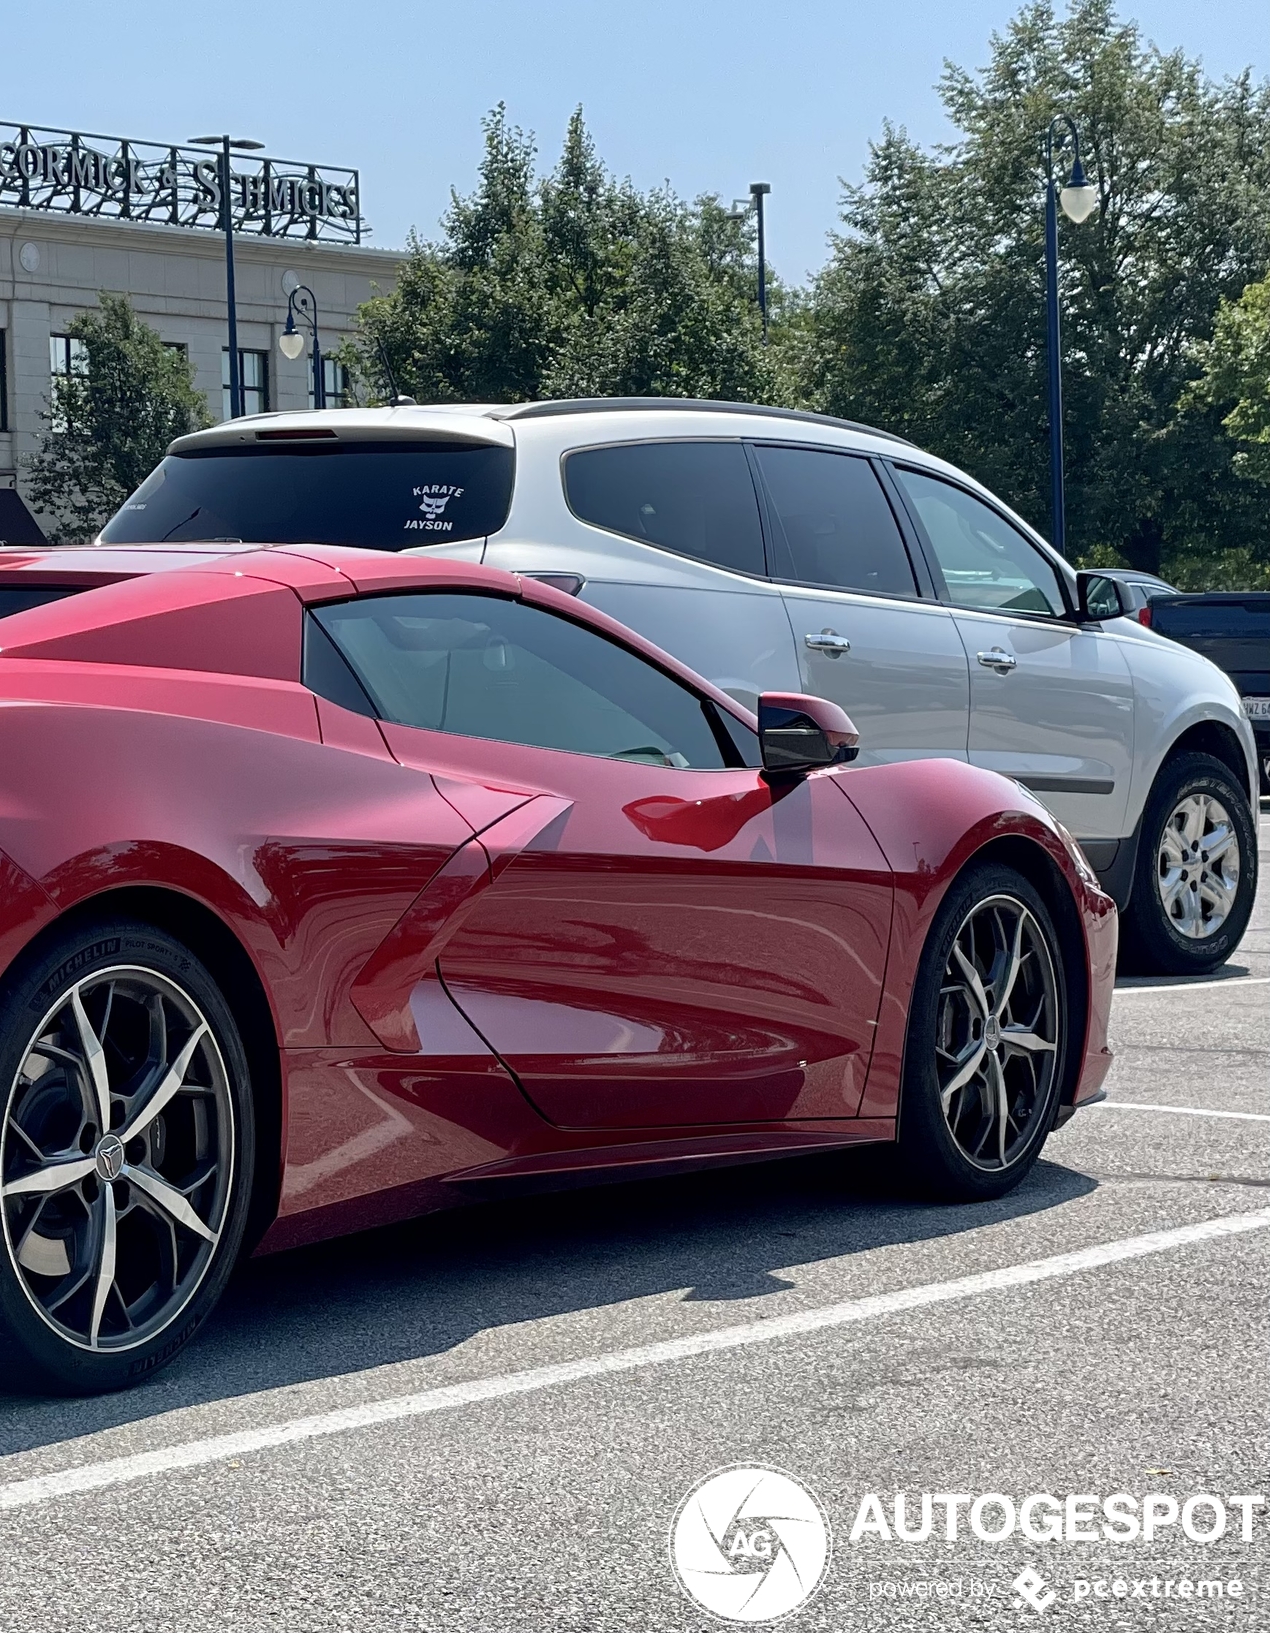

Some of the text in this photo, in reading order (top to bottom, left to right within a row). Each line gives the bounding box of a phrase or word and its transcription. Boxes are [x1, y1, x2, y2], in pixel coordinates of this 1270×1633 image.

[162, 166, 179, 189] &
[412, 484, 465, 498] KARATE
[404, 520, 453, 531] JAYSON
[48, 939, 118, 992] MICHELIN
[124, 940, 146, 949] PILOT
[147, 942, 169, 956] SPORT
